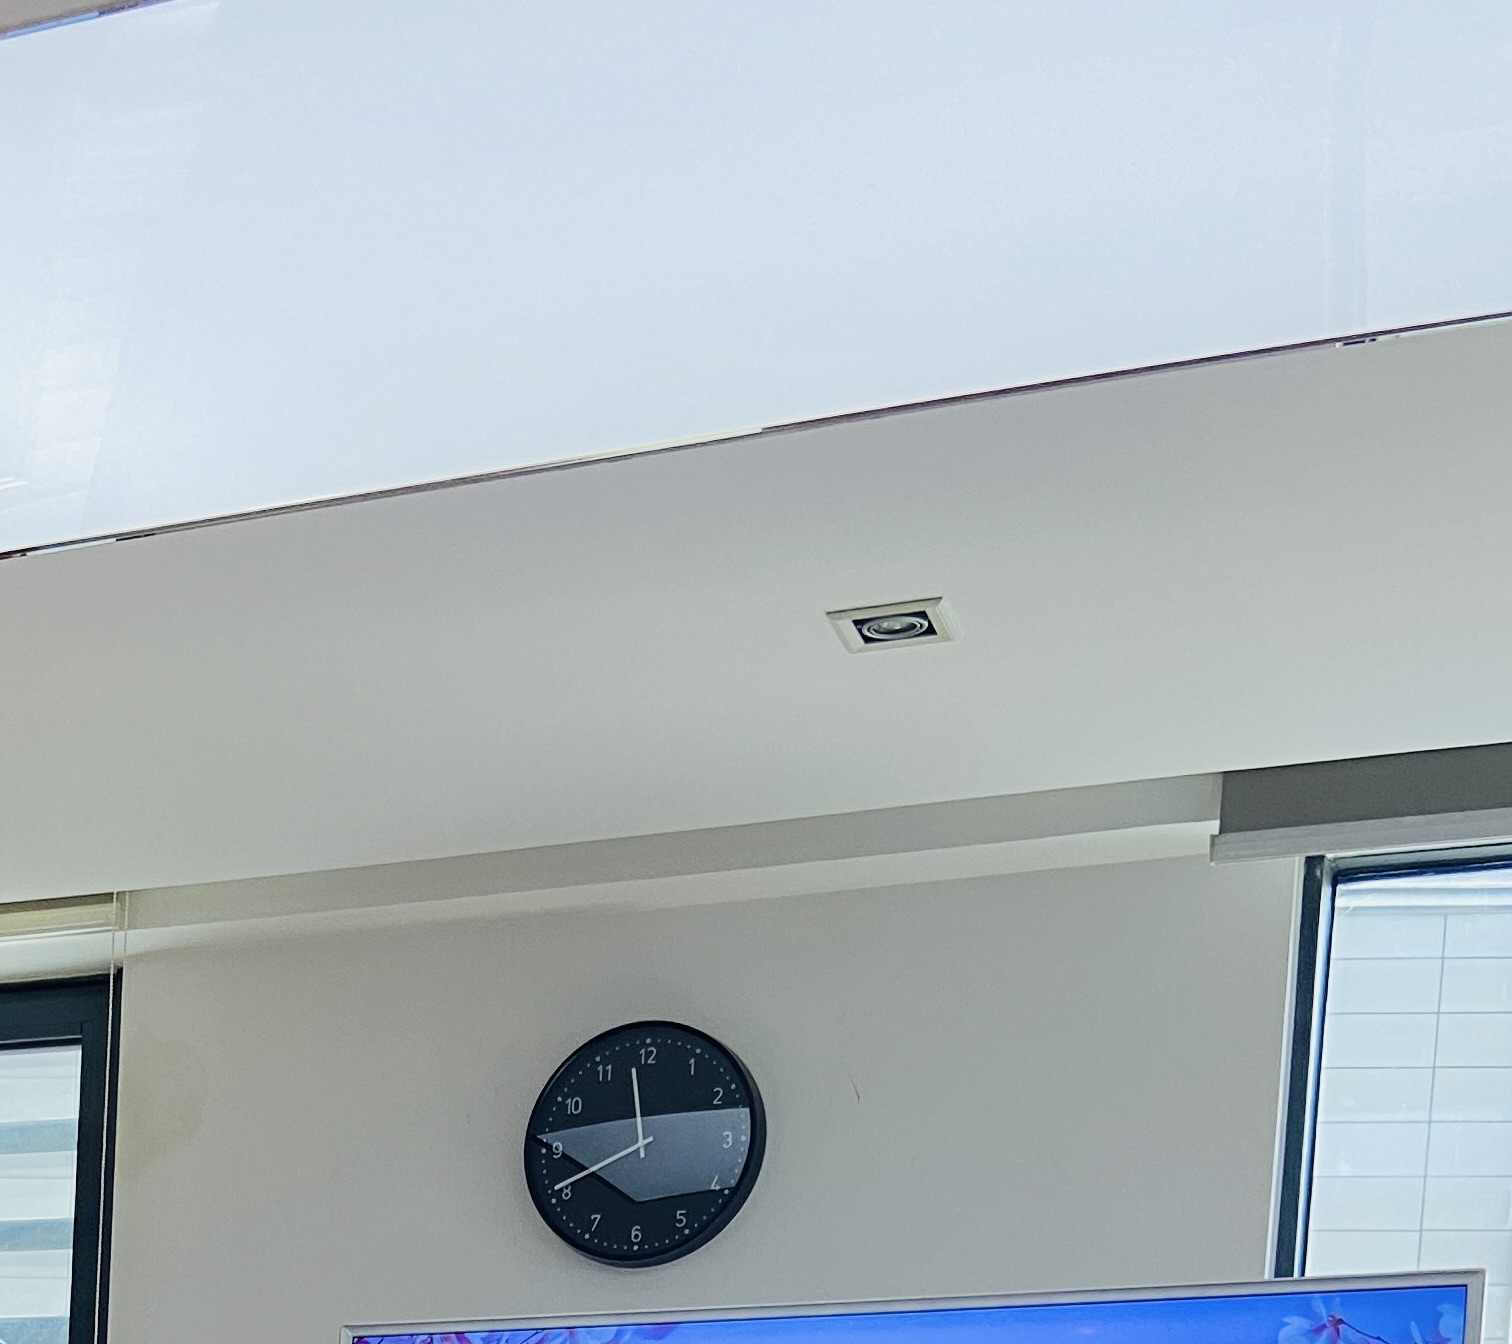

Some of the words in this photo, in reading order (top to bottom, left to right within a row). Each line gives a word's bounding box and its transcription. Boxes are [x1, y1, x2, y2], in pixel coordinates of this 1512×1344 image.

[639, 1047, 657, 1064] 12
[597, 1064, 613, 1082] 11
[688, 1057, 696, 1075] 1
[712, 1087, 724, 1105] 2
[565, 1097, 582, 1115] 10
[722, 1131, 733, 1149] 3
[552, 1142, 563, 1159] 9
[710, 1175, 721, 1190] 4
[562, 1184, 572, 1200] 8
[591, 1214, 602, 1231] 7
[675, 1210, 687, 1227] 5
[631, 1225, 642, 1242] 6
